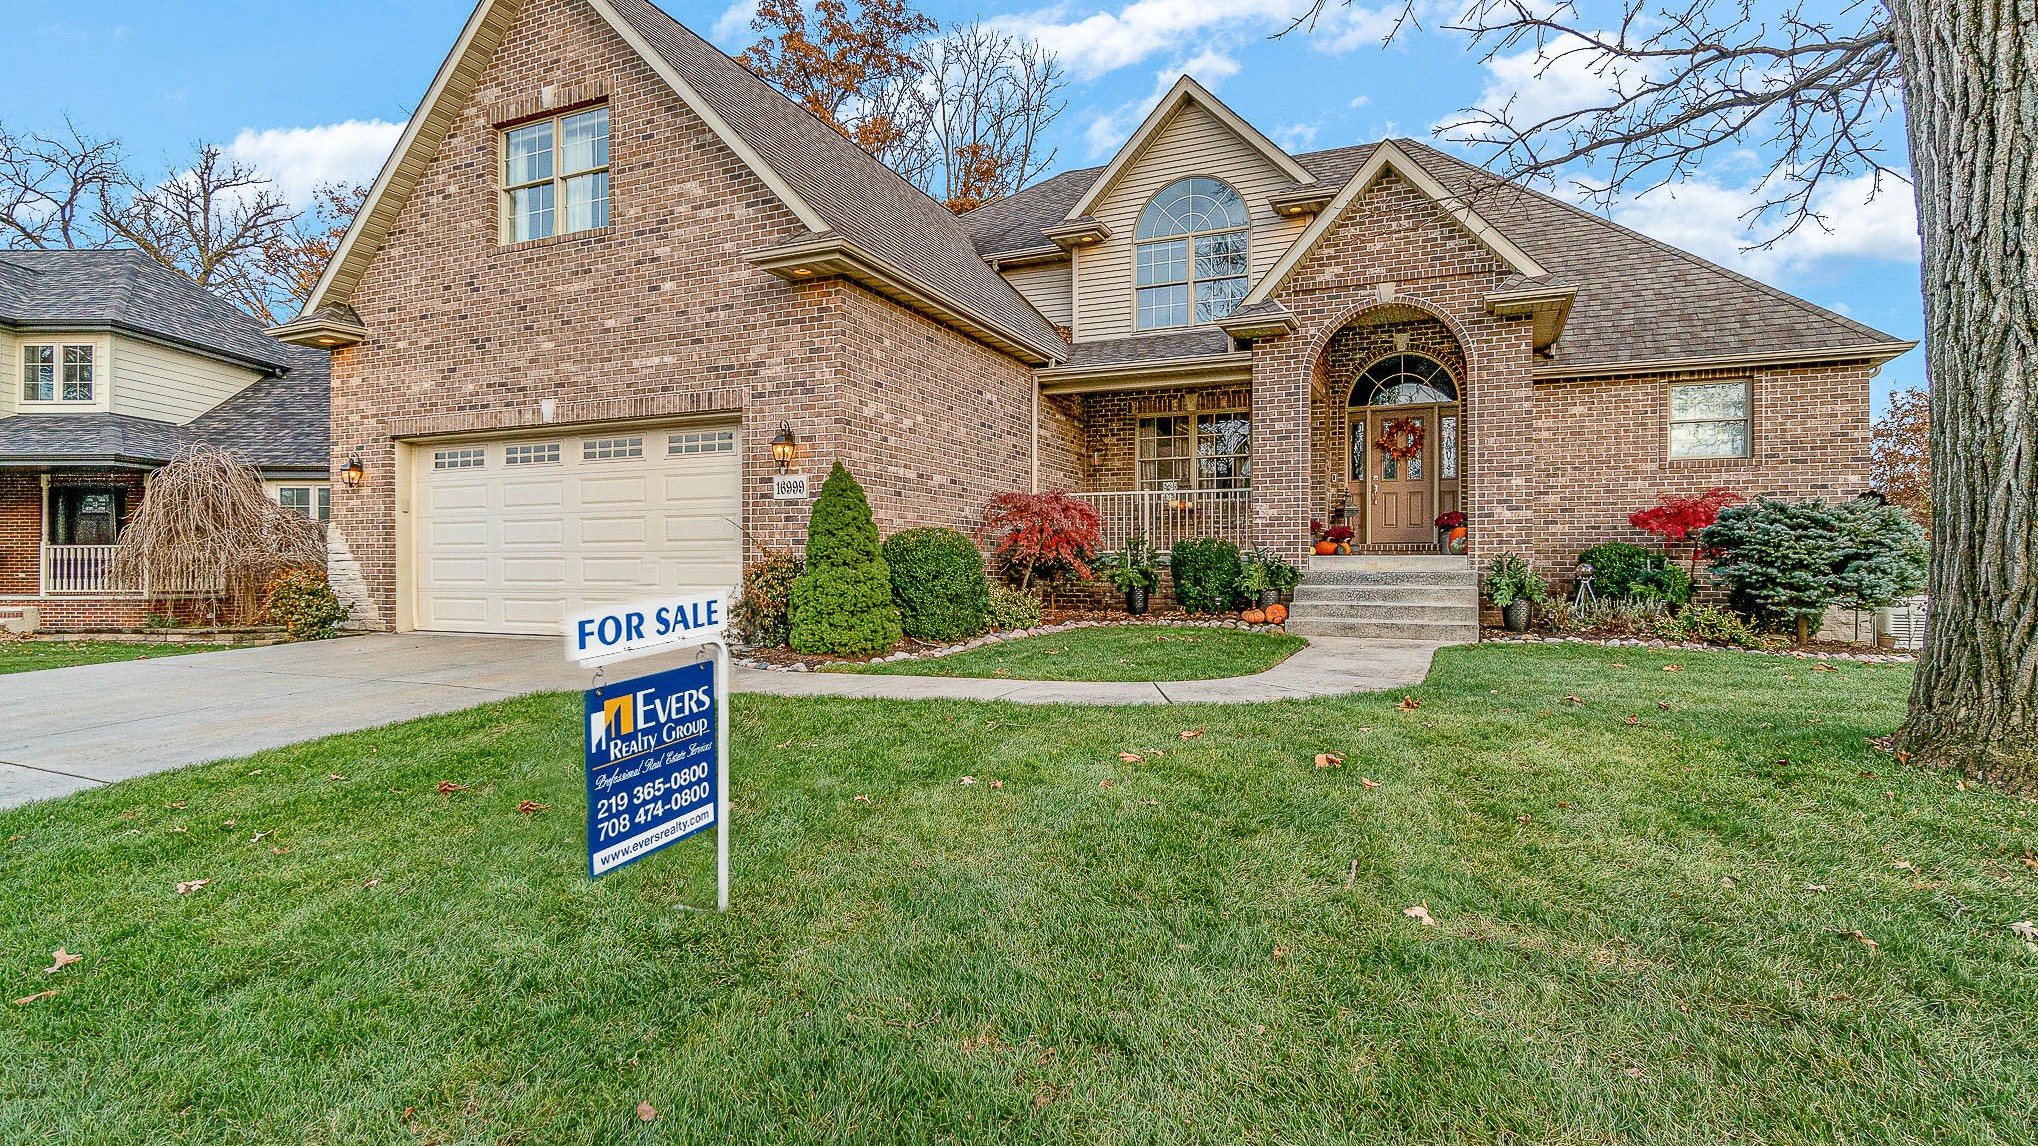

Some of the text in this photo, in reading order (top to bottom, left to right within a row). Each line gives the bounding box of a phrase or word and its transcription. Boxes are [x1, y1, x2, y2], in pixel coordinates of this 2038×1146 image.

[776, 480, 805, 494] 16999
[578, 599, 718, 650] FOR SALE
[636, 685, 710, 730] EVERS
[595, 741, 712, 792] Professional Real Estate Services
[597, 762, 708, 819] 219 365-0800
[597, 782, 710, 842] 708 474-0800
[600, 809, 710, 866] www.eversrealty.com
